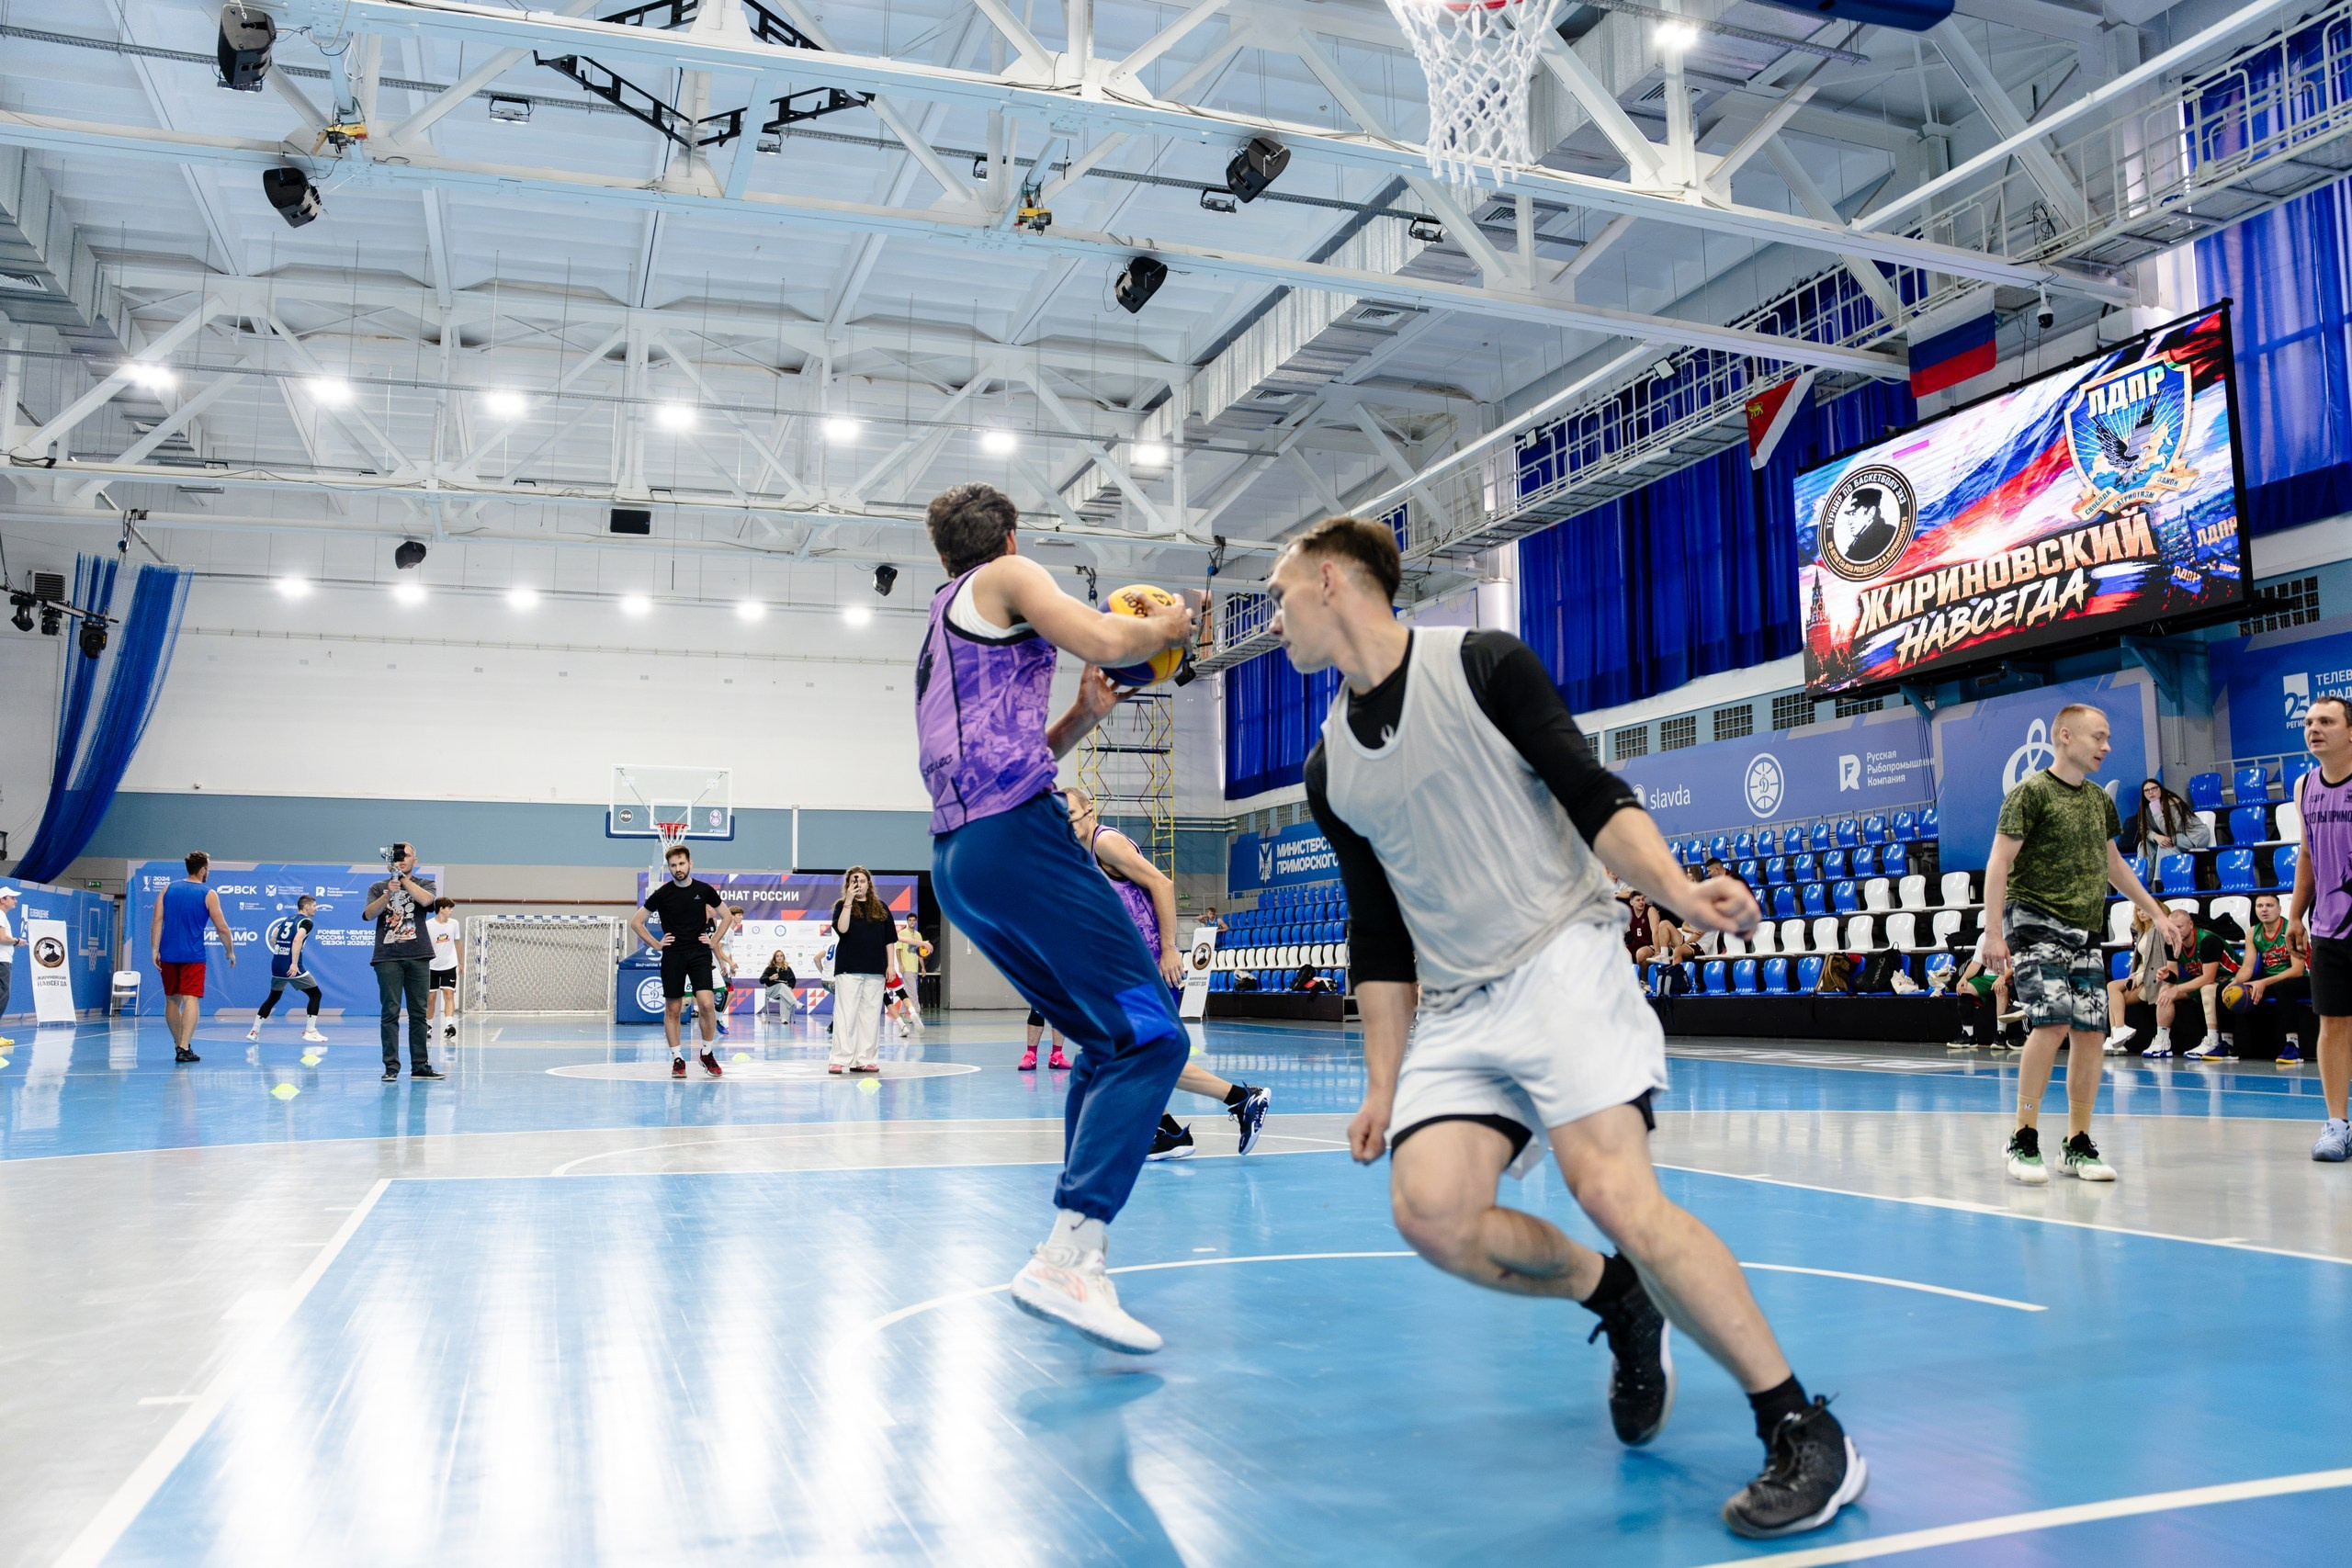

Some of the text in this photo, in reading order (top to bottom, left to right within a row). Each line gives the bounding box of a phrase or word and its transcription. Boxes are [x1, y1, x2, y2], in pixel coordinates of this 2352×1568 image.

[2087, 366, 2165, 418] ЛДПР
[1826, 494, 1843, 529] ТУРНИР
[1842, 485, 1853, 496] ПО
[1853, 473, 1899, 491] БАСКЕТБОЛУ
[2085, 490, 2111, 515] СВОБОДА
[2197, 515, 2238, 547] ЛДПР
[1854, 505, 2158, 640] ЖИРИНОВСКИЙ
[1895, 566, 2090, 671] НАВСЕГДА
[2315, 669, 2352, 686] ТЕЛЕВ
[1866, 750, 1897, 763] Русская
[1867, 774, 1905, 787] Компания
[1650, 784, 1690, 809] slavda
[234, 885, 257, 895] ВСК
[752, 890, 799, 902] РОССИИ
[281, 921, 294, 939] 3
[1636, 928, 1643, 937] 6
[826, 943, 836, 961] 9
